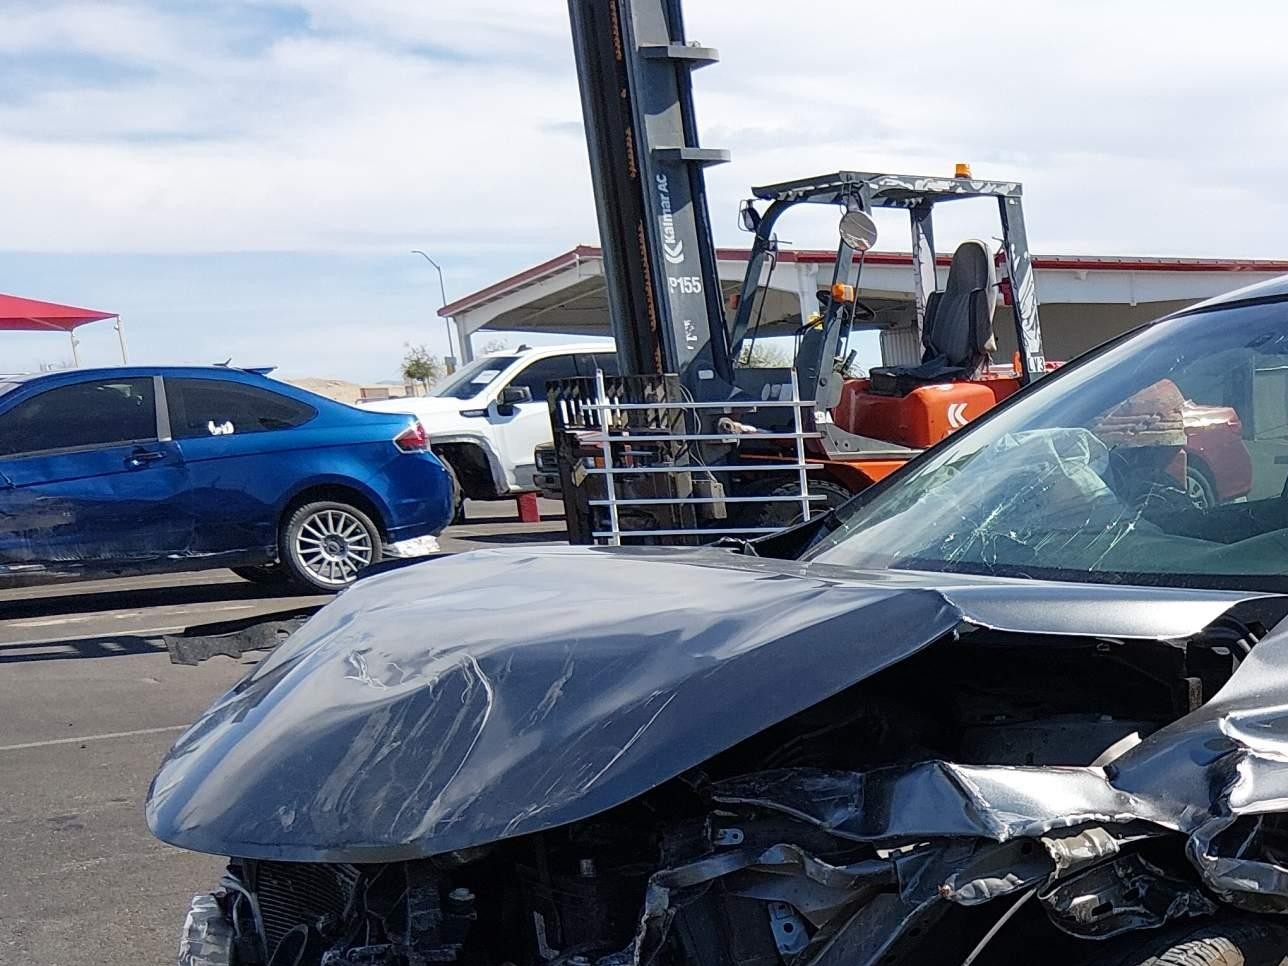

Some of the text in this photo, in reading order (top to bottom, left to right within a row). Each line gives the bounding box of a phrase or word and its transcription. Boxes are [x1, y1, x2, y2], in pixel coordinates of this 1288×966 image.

[657, 173, 676, 244] Kalmar AC
[668, 277, 702, 293] P155
